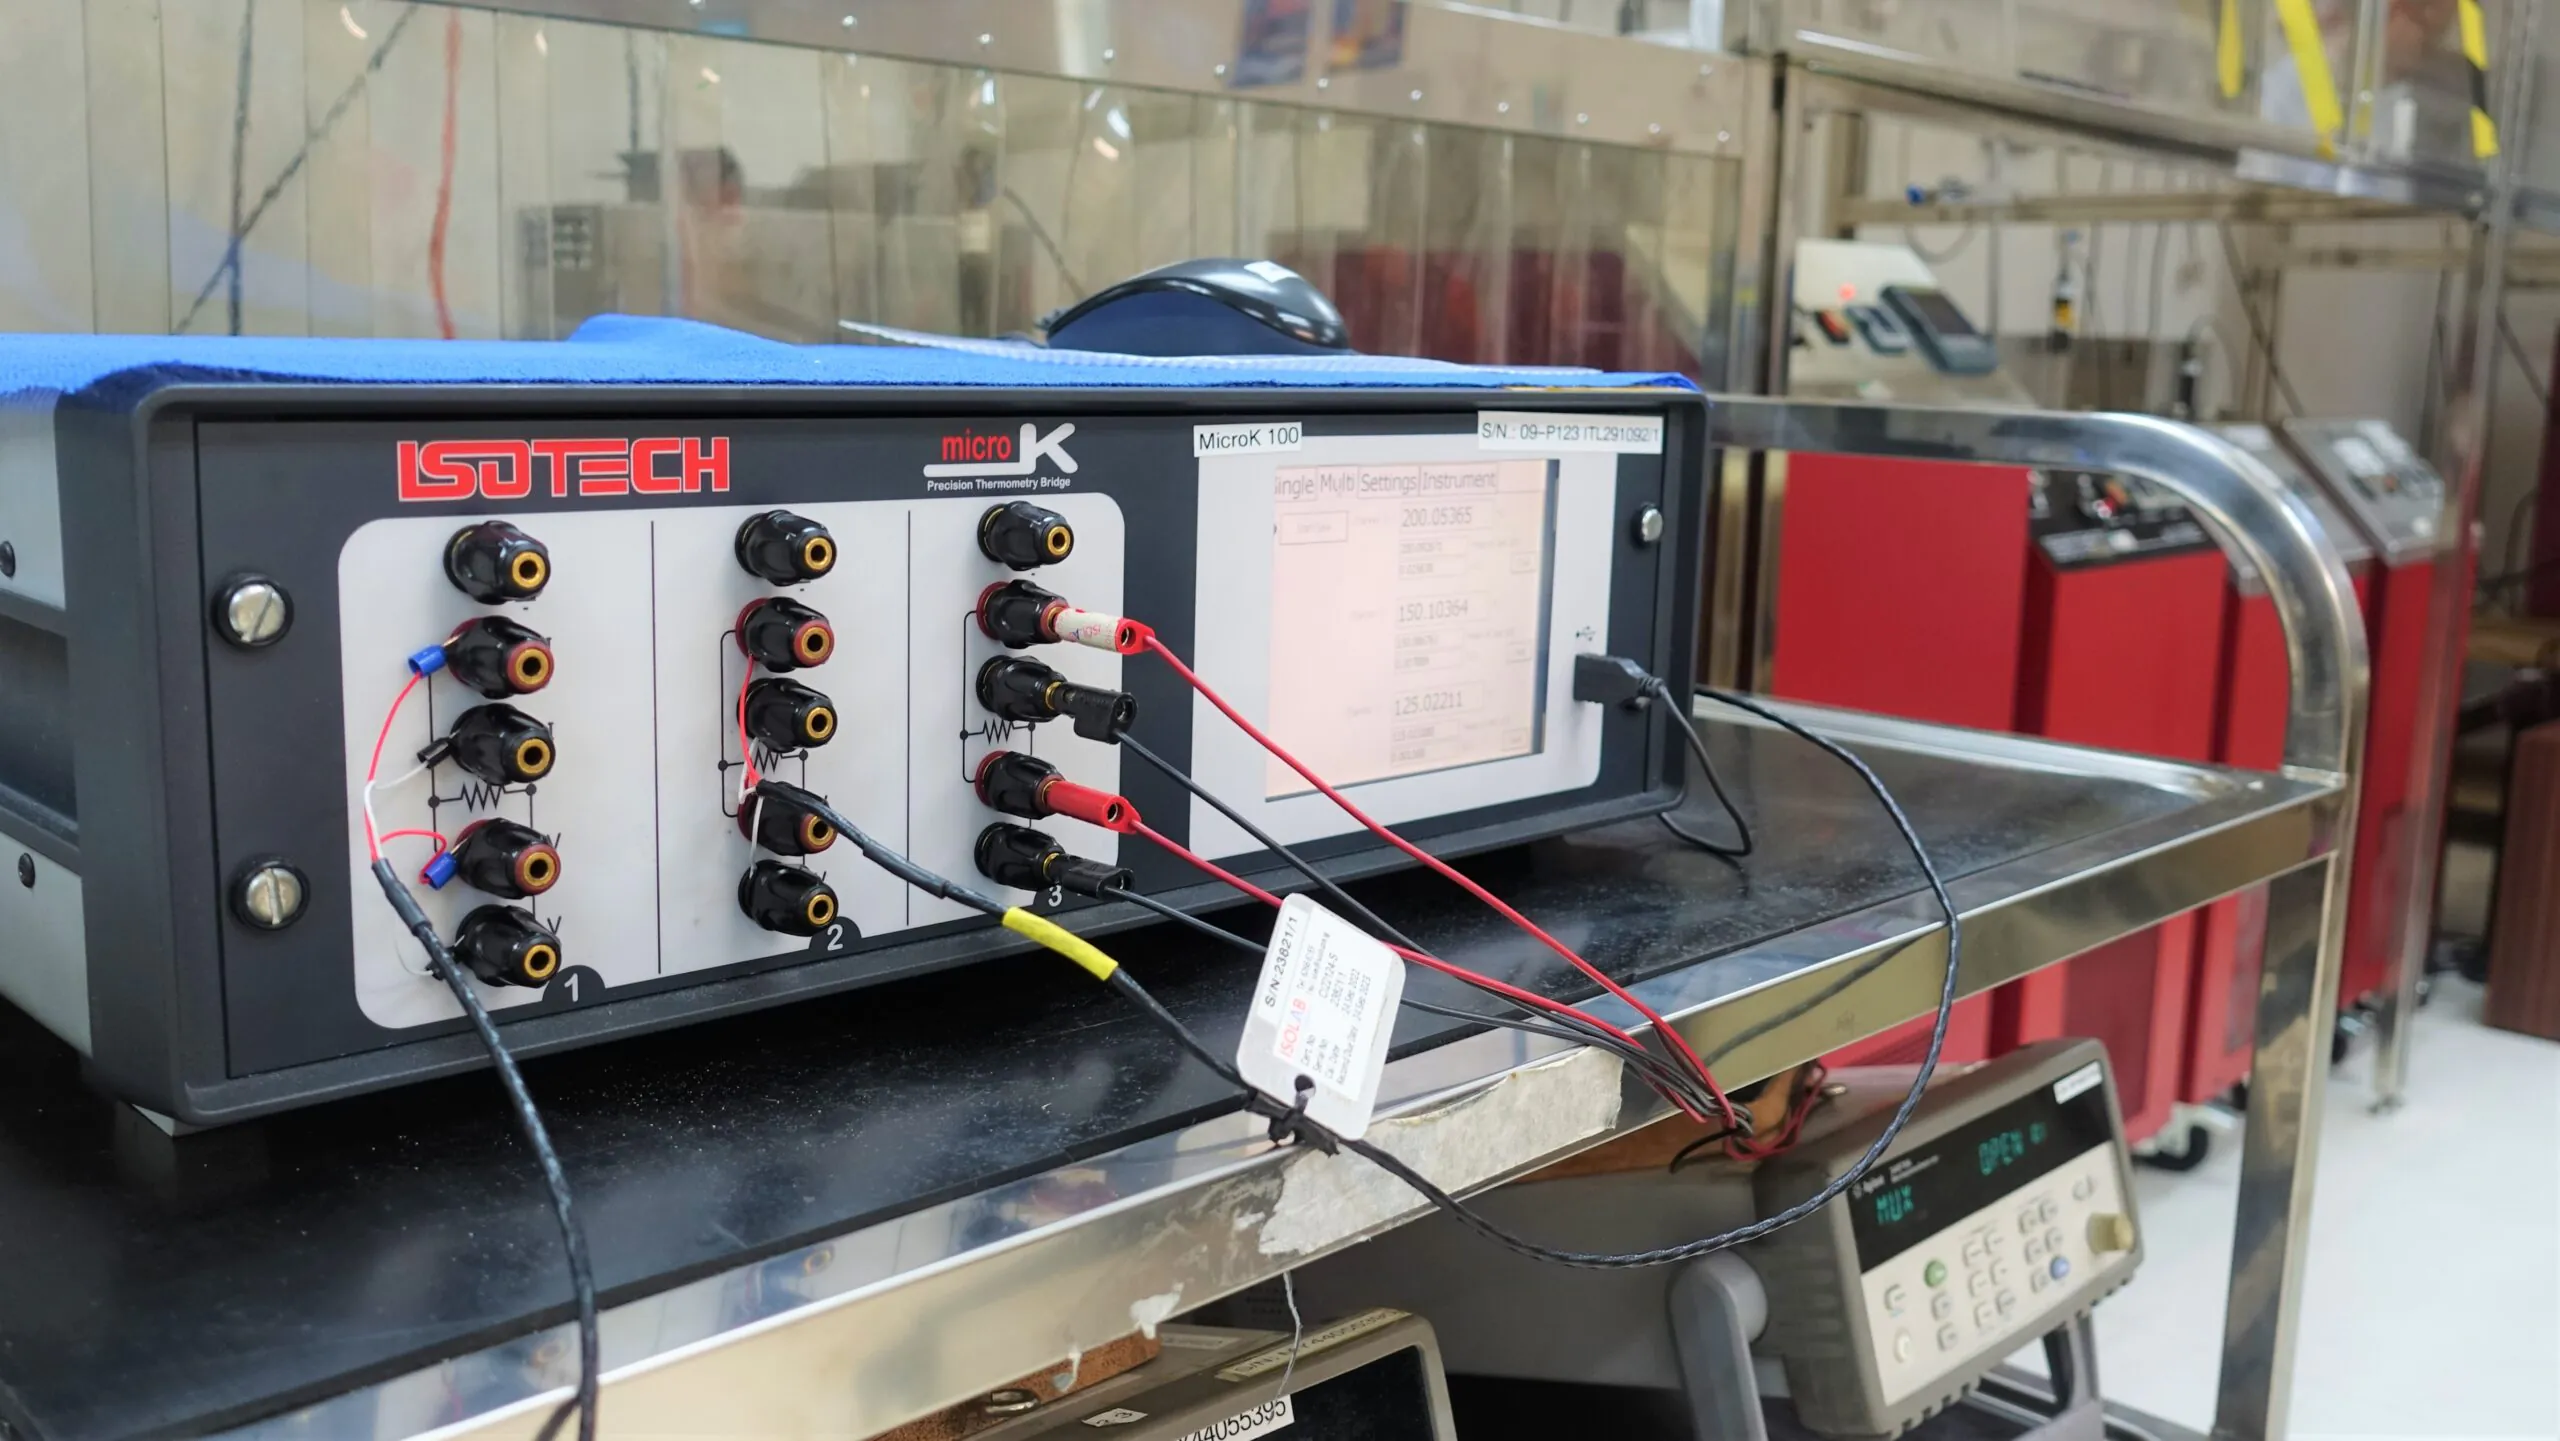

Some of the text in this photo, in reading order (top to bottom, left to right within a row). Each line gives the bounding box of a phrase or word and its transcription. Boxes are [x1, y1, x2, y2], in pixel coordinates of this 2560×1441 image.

[942, 427, 1012, 461] micro
[1199, 426, 1299, 450] MicroK 100
[1520, 423, 1580, 441] 09-P123
[1583, 425, 1659, 442] ITL291092/1
[397, 437, 730, 502] ISOTECH
[1422, 471, 1497, 490] Instrument
[927, 476, 1071, 492] Precision Thermometry Bridge
[1320, 471, 1356, 493] Multi
[1360, 472, 1417, 495] Settings
[1402, 506, 1473, 528] 200.05365
[1399, 600, 1468, 622] 150.10364
[1395, 690, 1463, 716] 125.02211
[1048, 884, 1062, 907] 3
[827, 923, 843, 951] 2
[1265, 916, 1297, 1008] S/N:23821/1
[564, 972, 579, 1002] 1
